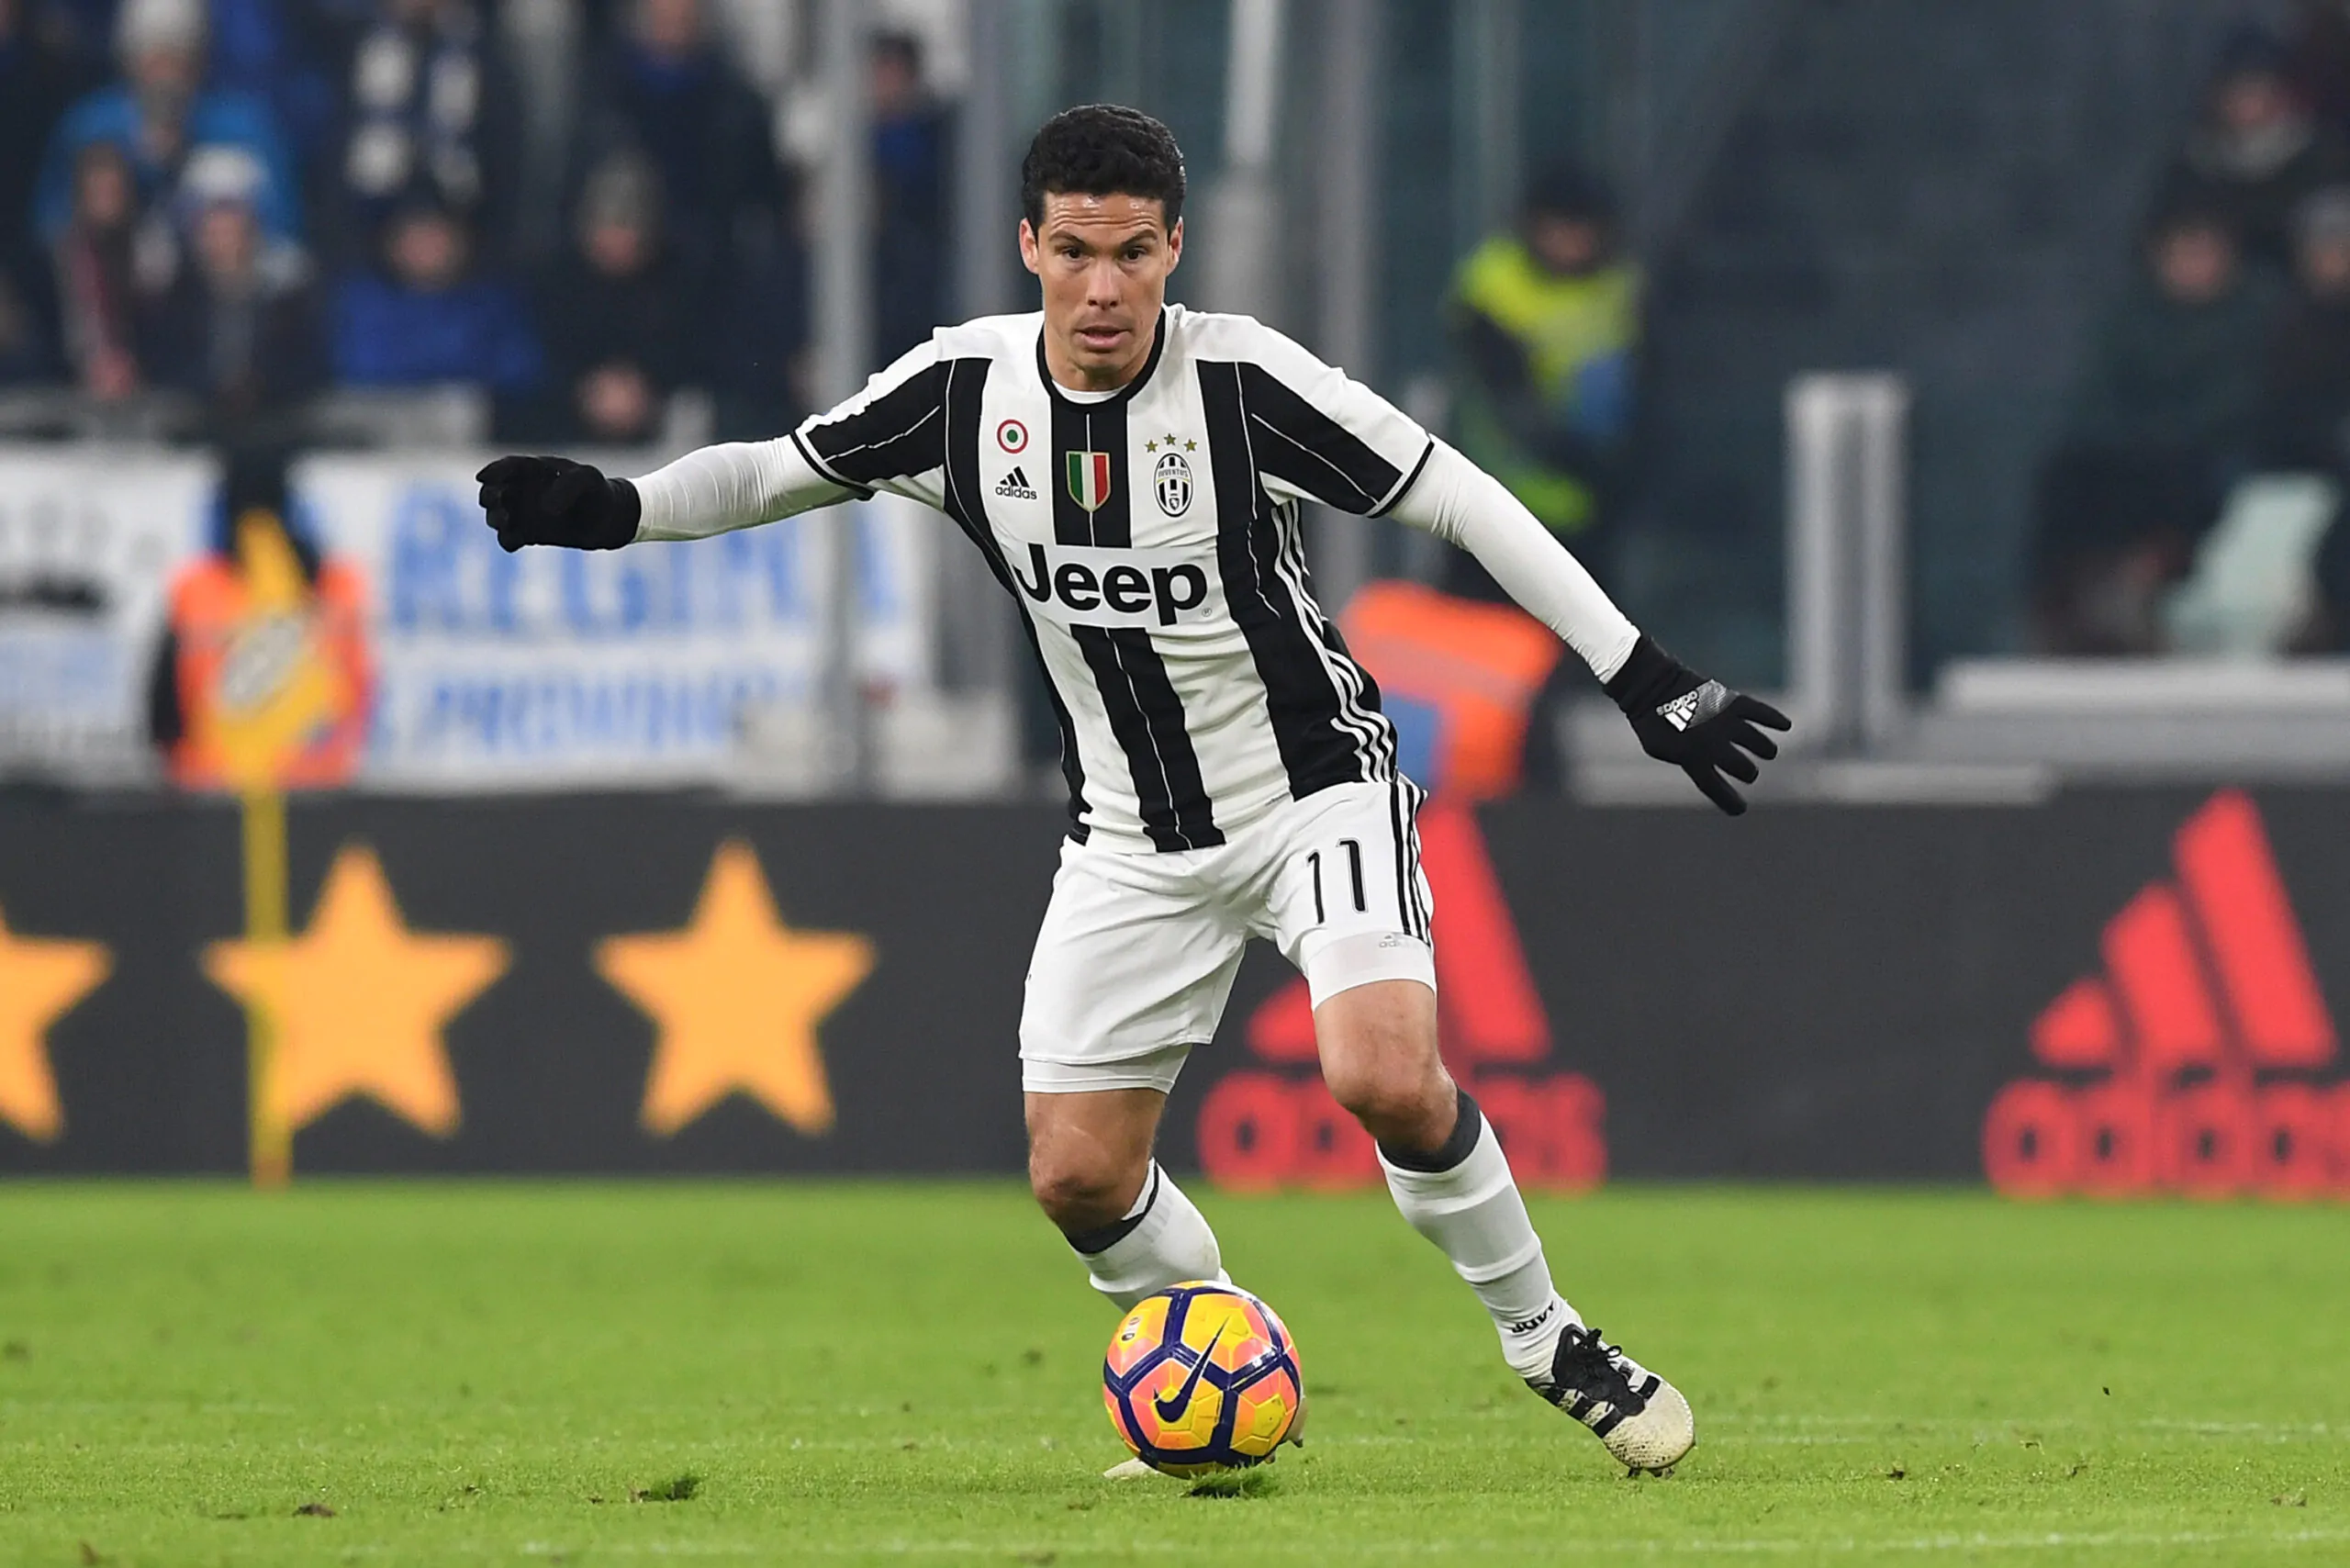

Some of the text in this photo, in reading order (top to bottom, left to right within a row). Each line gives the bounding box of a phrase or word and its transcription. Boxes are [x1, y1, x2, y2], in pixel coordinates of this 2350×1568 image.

[995, 482, 1037, 500] adidas
[1012, 543, 1208, 626] Jeep
[1656, 690, 1698, 716] adidas
[1305, 837, 1369, 925] 11
[1198, 1065, 1610, 1196] adas
